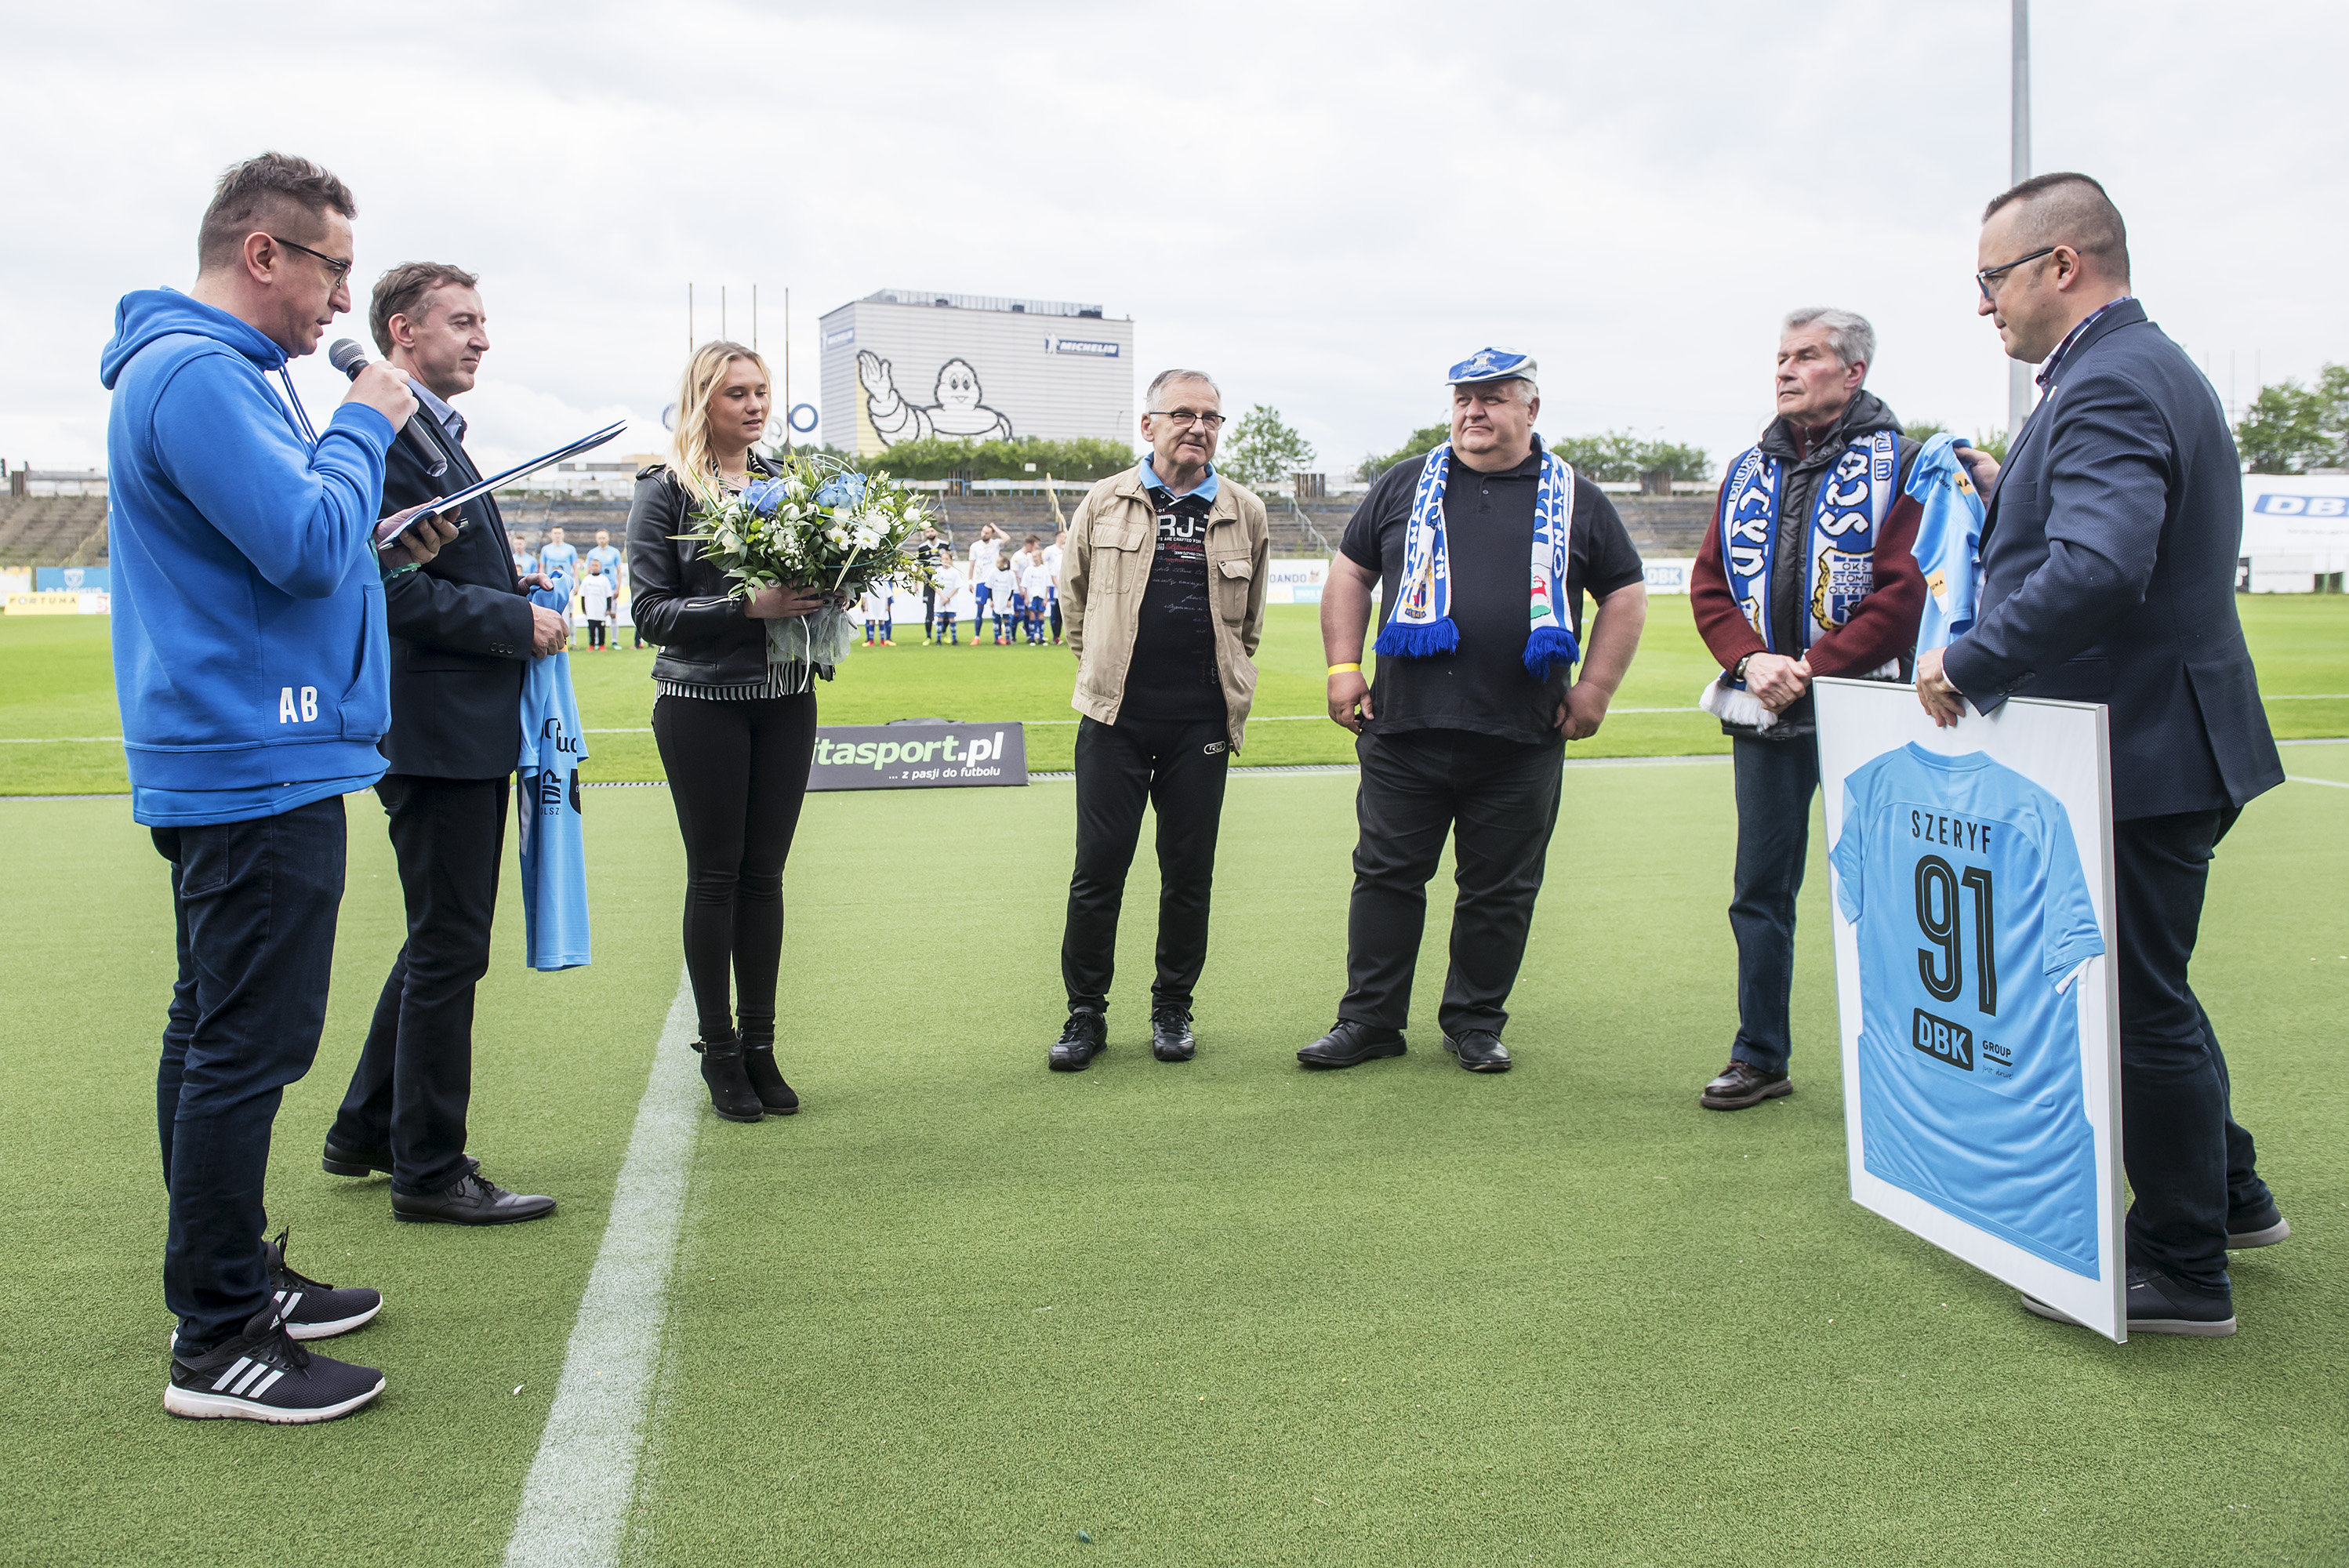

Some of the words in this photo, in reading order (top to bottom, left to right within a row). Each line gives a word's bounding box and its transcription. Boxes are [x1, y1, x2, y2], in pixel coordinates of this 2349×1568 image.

[1059, 341, 1118, 354] MICHELIN
[2264, 495, 2349, 517] DB
[1842, 562, 1868, 571] OKS
[1647, 568, 1681, 585] DBK
[1828, 586, 1875, 594] OLSZTYN
[280, 686, 318, 724] AB
[912, 768, 939, 780] pasji
[942, 767, 957, 778] do
[960, 766, 1000, 777] futbolu
[539, 807, 561, 815] OLSZ
[1912, 809, 1991, 855] SZERYF
[1915, 855, 1997, 1017] 91
[1919, 1014, 1970, 1065] DBK
[1982, 1040, 2012, 1058] GROUP
